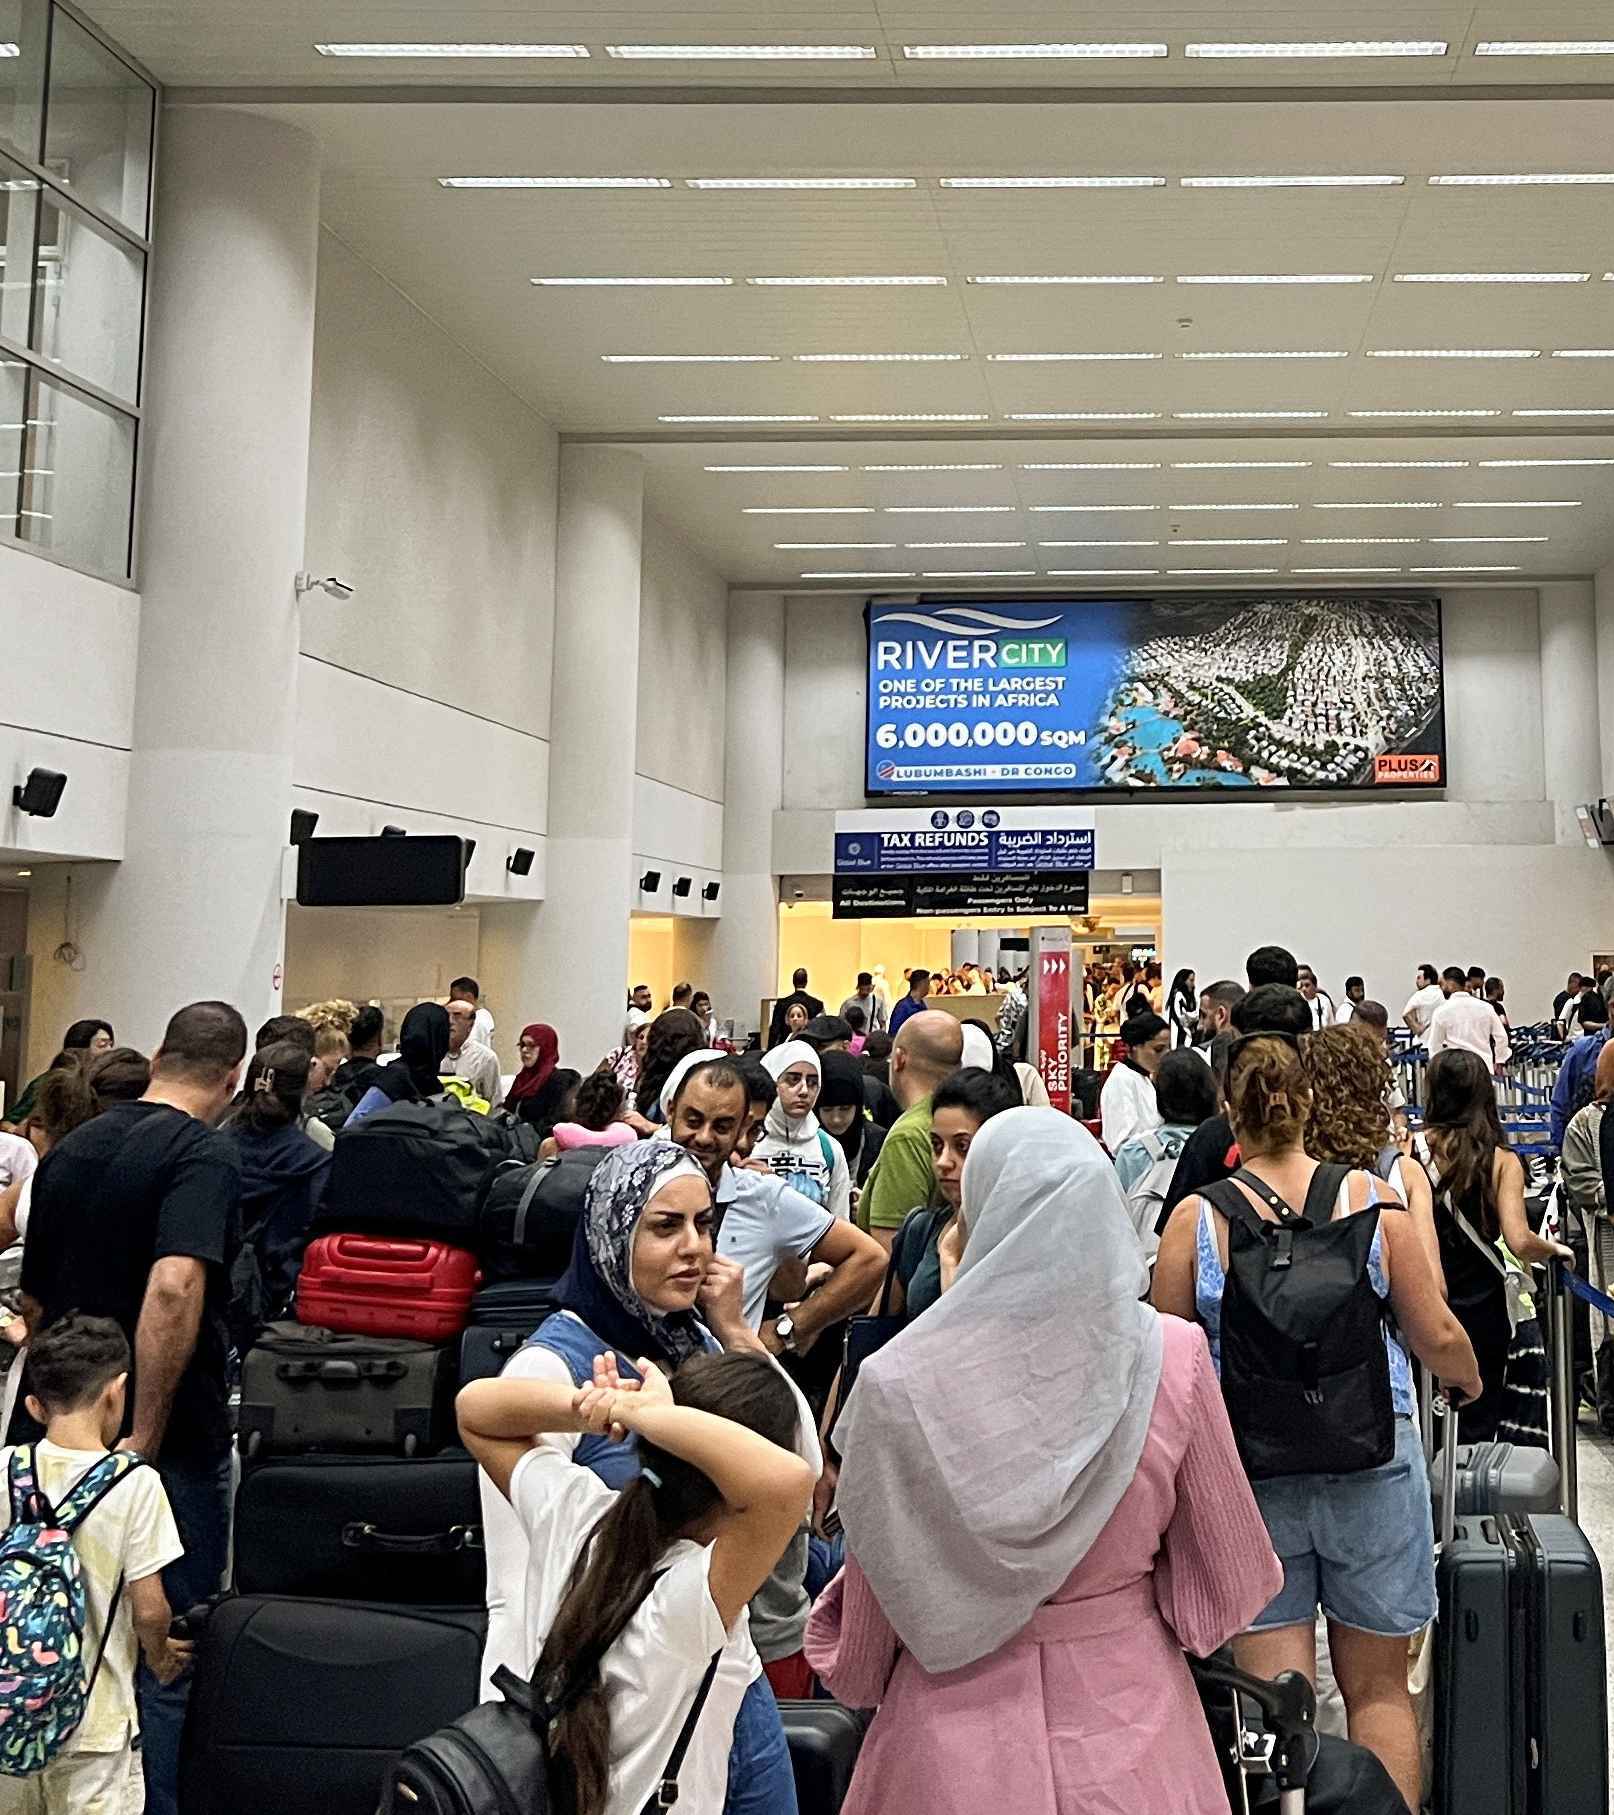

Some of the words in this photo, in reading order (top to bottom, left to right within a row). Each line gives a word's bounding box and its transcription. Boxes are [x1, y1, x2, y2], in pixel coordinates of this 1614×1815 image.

[876, 639, 997, 670] RIVER
[1001, 643, 1065, 665] CITY
[878, 678, 917, 693] ONE
[921, 678, 946, 692] OF
[951, 677, 984, 692] THE
[988, 677, 1066, 691] LARGEST
[879, 694, 968, 709] PROJECTS
[972, 694, 990, 708] IN
[995, 693, 1059, 707] AFRICA
[876, 721, 1038, 749] 6,000,000
[1039, 730, 1087, 749] SQM
[896, 767, 988, 779] LUBUMBASHI
[1000, 767, 1019, 777] DR
[1024, 766, 1074, 776] CONGO
[1378, 759, 1419, 772] PLUS
[881, 833, 912, 848] TAX
[914, 832, 989, 847] REFUNDS
[998, 831, 1042, 848] الضريبة
[1045, 831, 1092, 847] استرداد
[1014, 896, 1033, 904] Only
[983, 906, 1005, 914] Entry
[1057, 1012, 1068, 1091] PRIORITY
[1047, 1057, 1058, 1092] SKY
